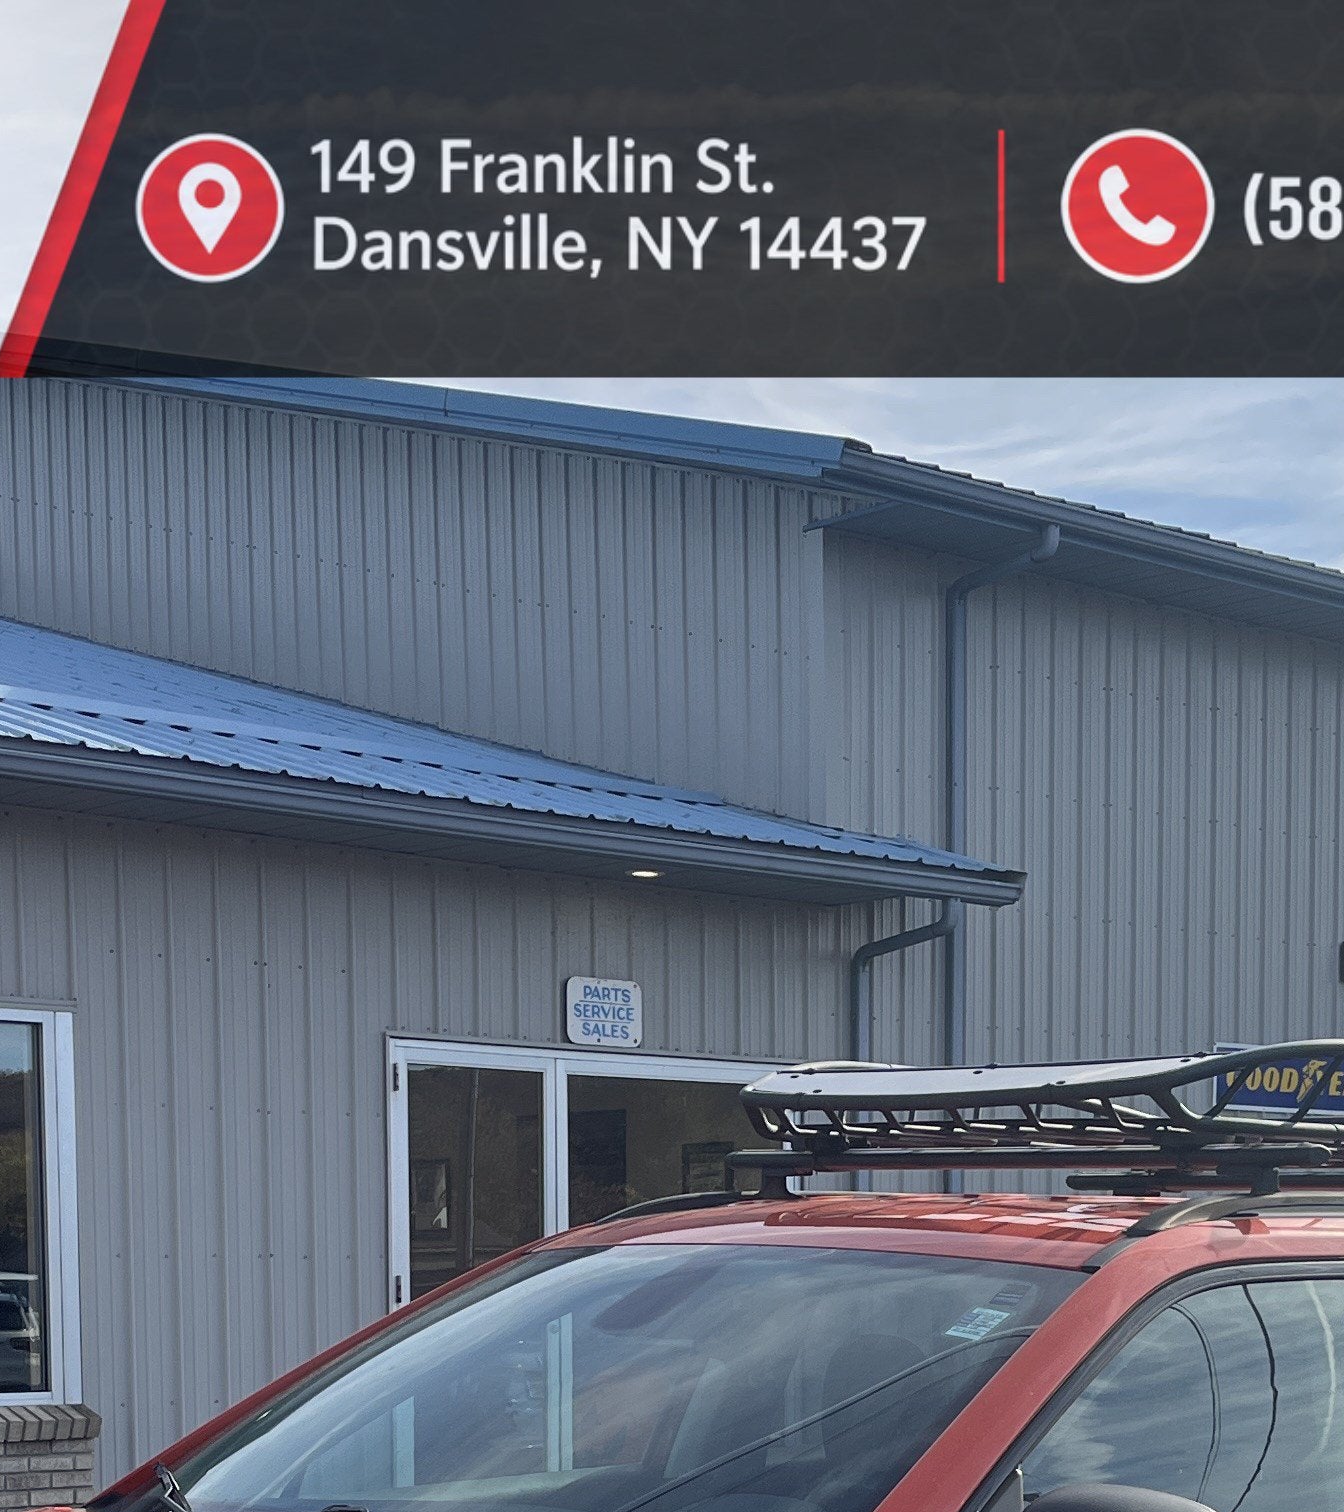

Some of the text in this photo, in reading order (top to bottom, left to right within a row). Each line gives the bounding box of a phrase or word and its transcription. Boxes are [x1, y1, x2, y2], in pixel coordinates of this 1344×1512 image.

[583, 985, 631, 1003] PARTS
[573, 1003, 635, 1021] SERVICE
[582, 1022, 630, 1040] SALES
